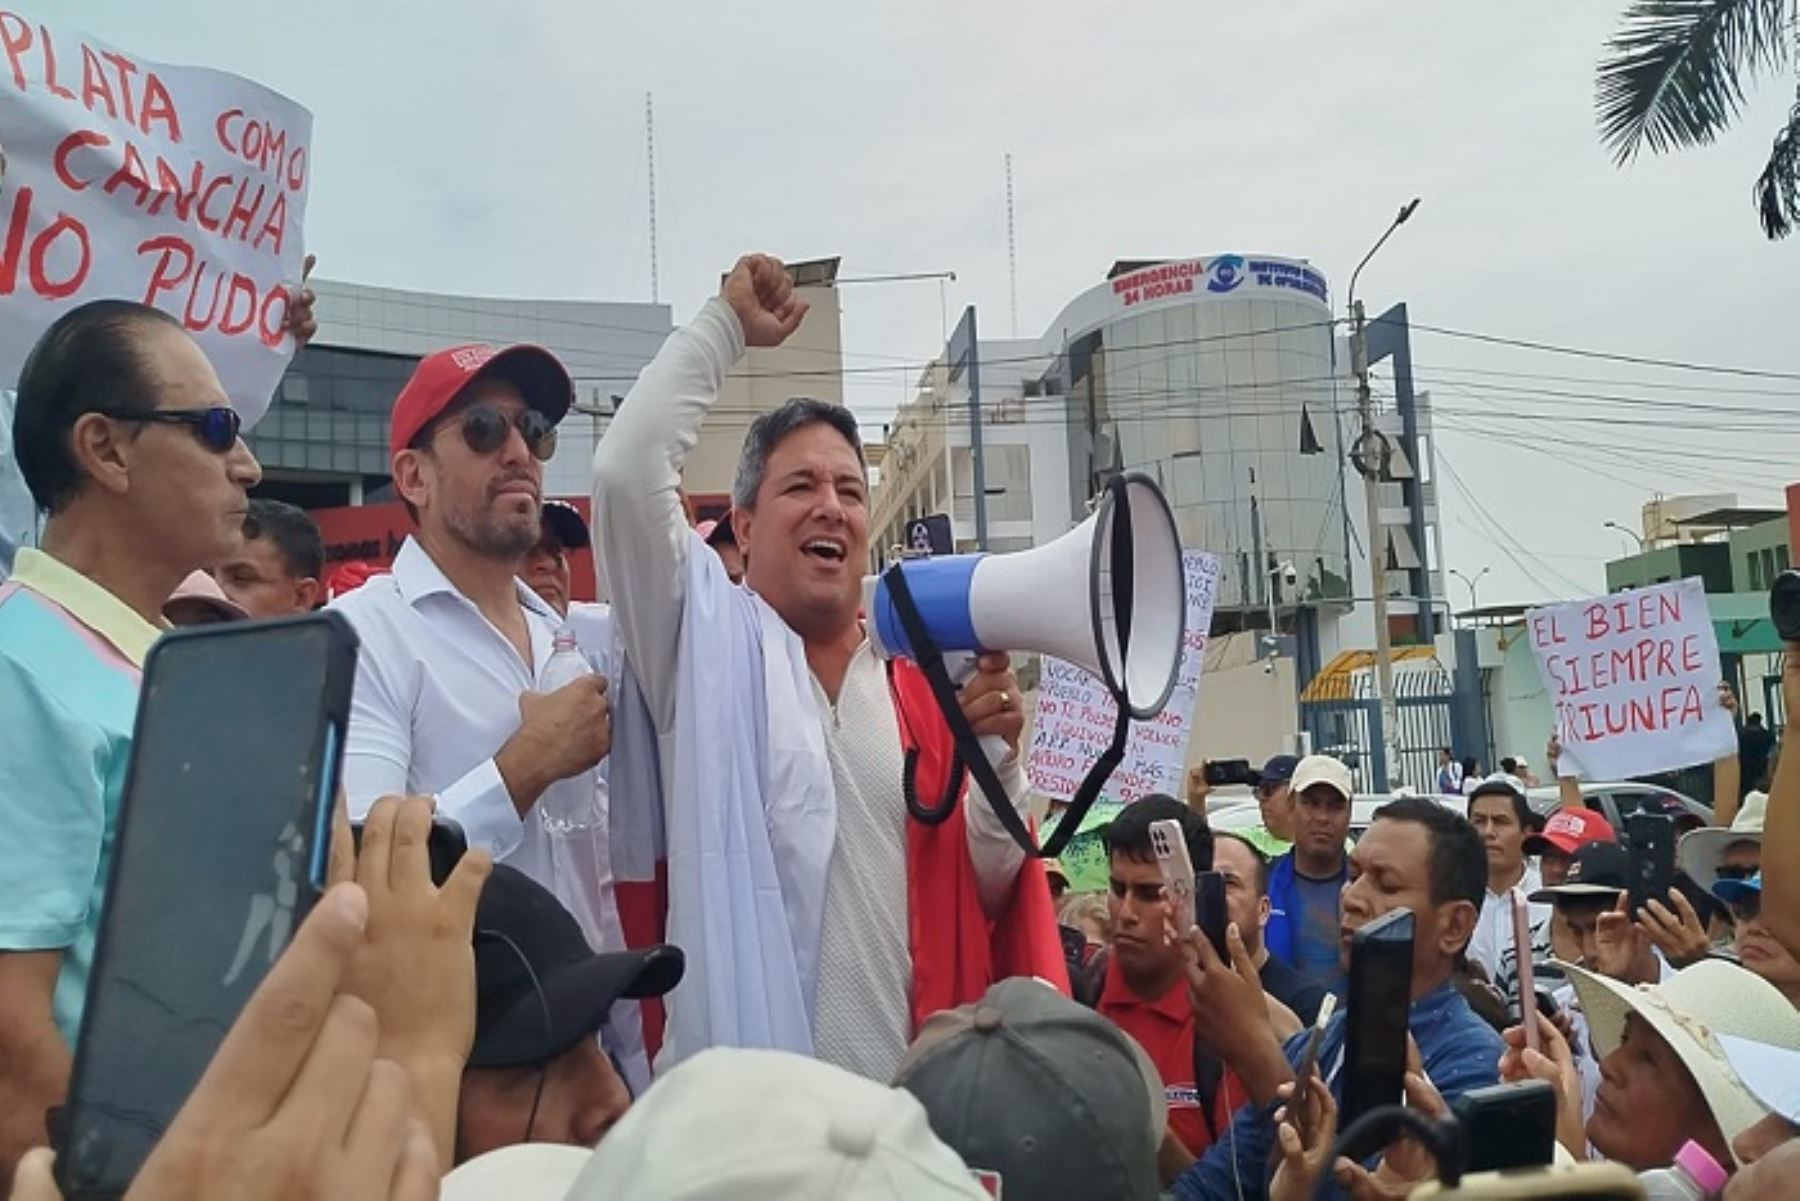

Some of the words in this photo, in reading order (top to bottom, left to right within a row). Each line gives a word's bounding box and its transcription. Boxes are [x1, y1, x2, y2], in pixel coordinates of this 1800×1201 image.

[0, 11, 181, 143] PLATA
[216, 110, 306, 190] COMO
[54, 130, 289, 255] CANCHA
[138, 236, 295, 348] PUDO
[1112, 260, 1203, 294] EMERGENCIA
[1143, 278, 1194, 301] HORAS
[1534, 615, 1567, 648] EL
[1583, 591, 1682, 640] BIEN
[1546, 634, 1704, 695] SIEMPRE
[1555, 684, 1703, 744] TRIUNFA
